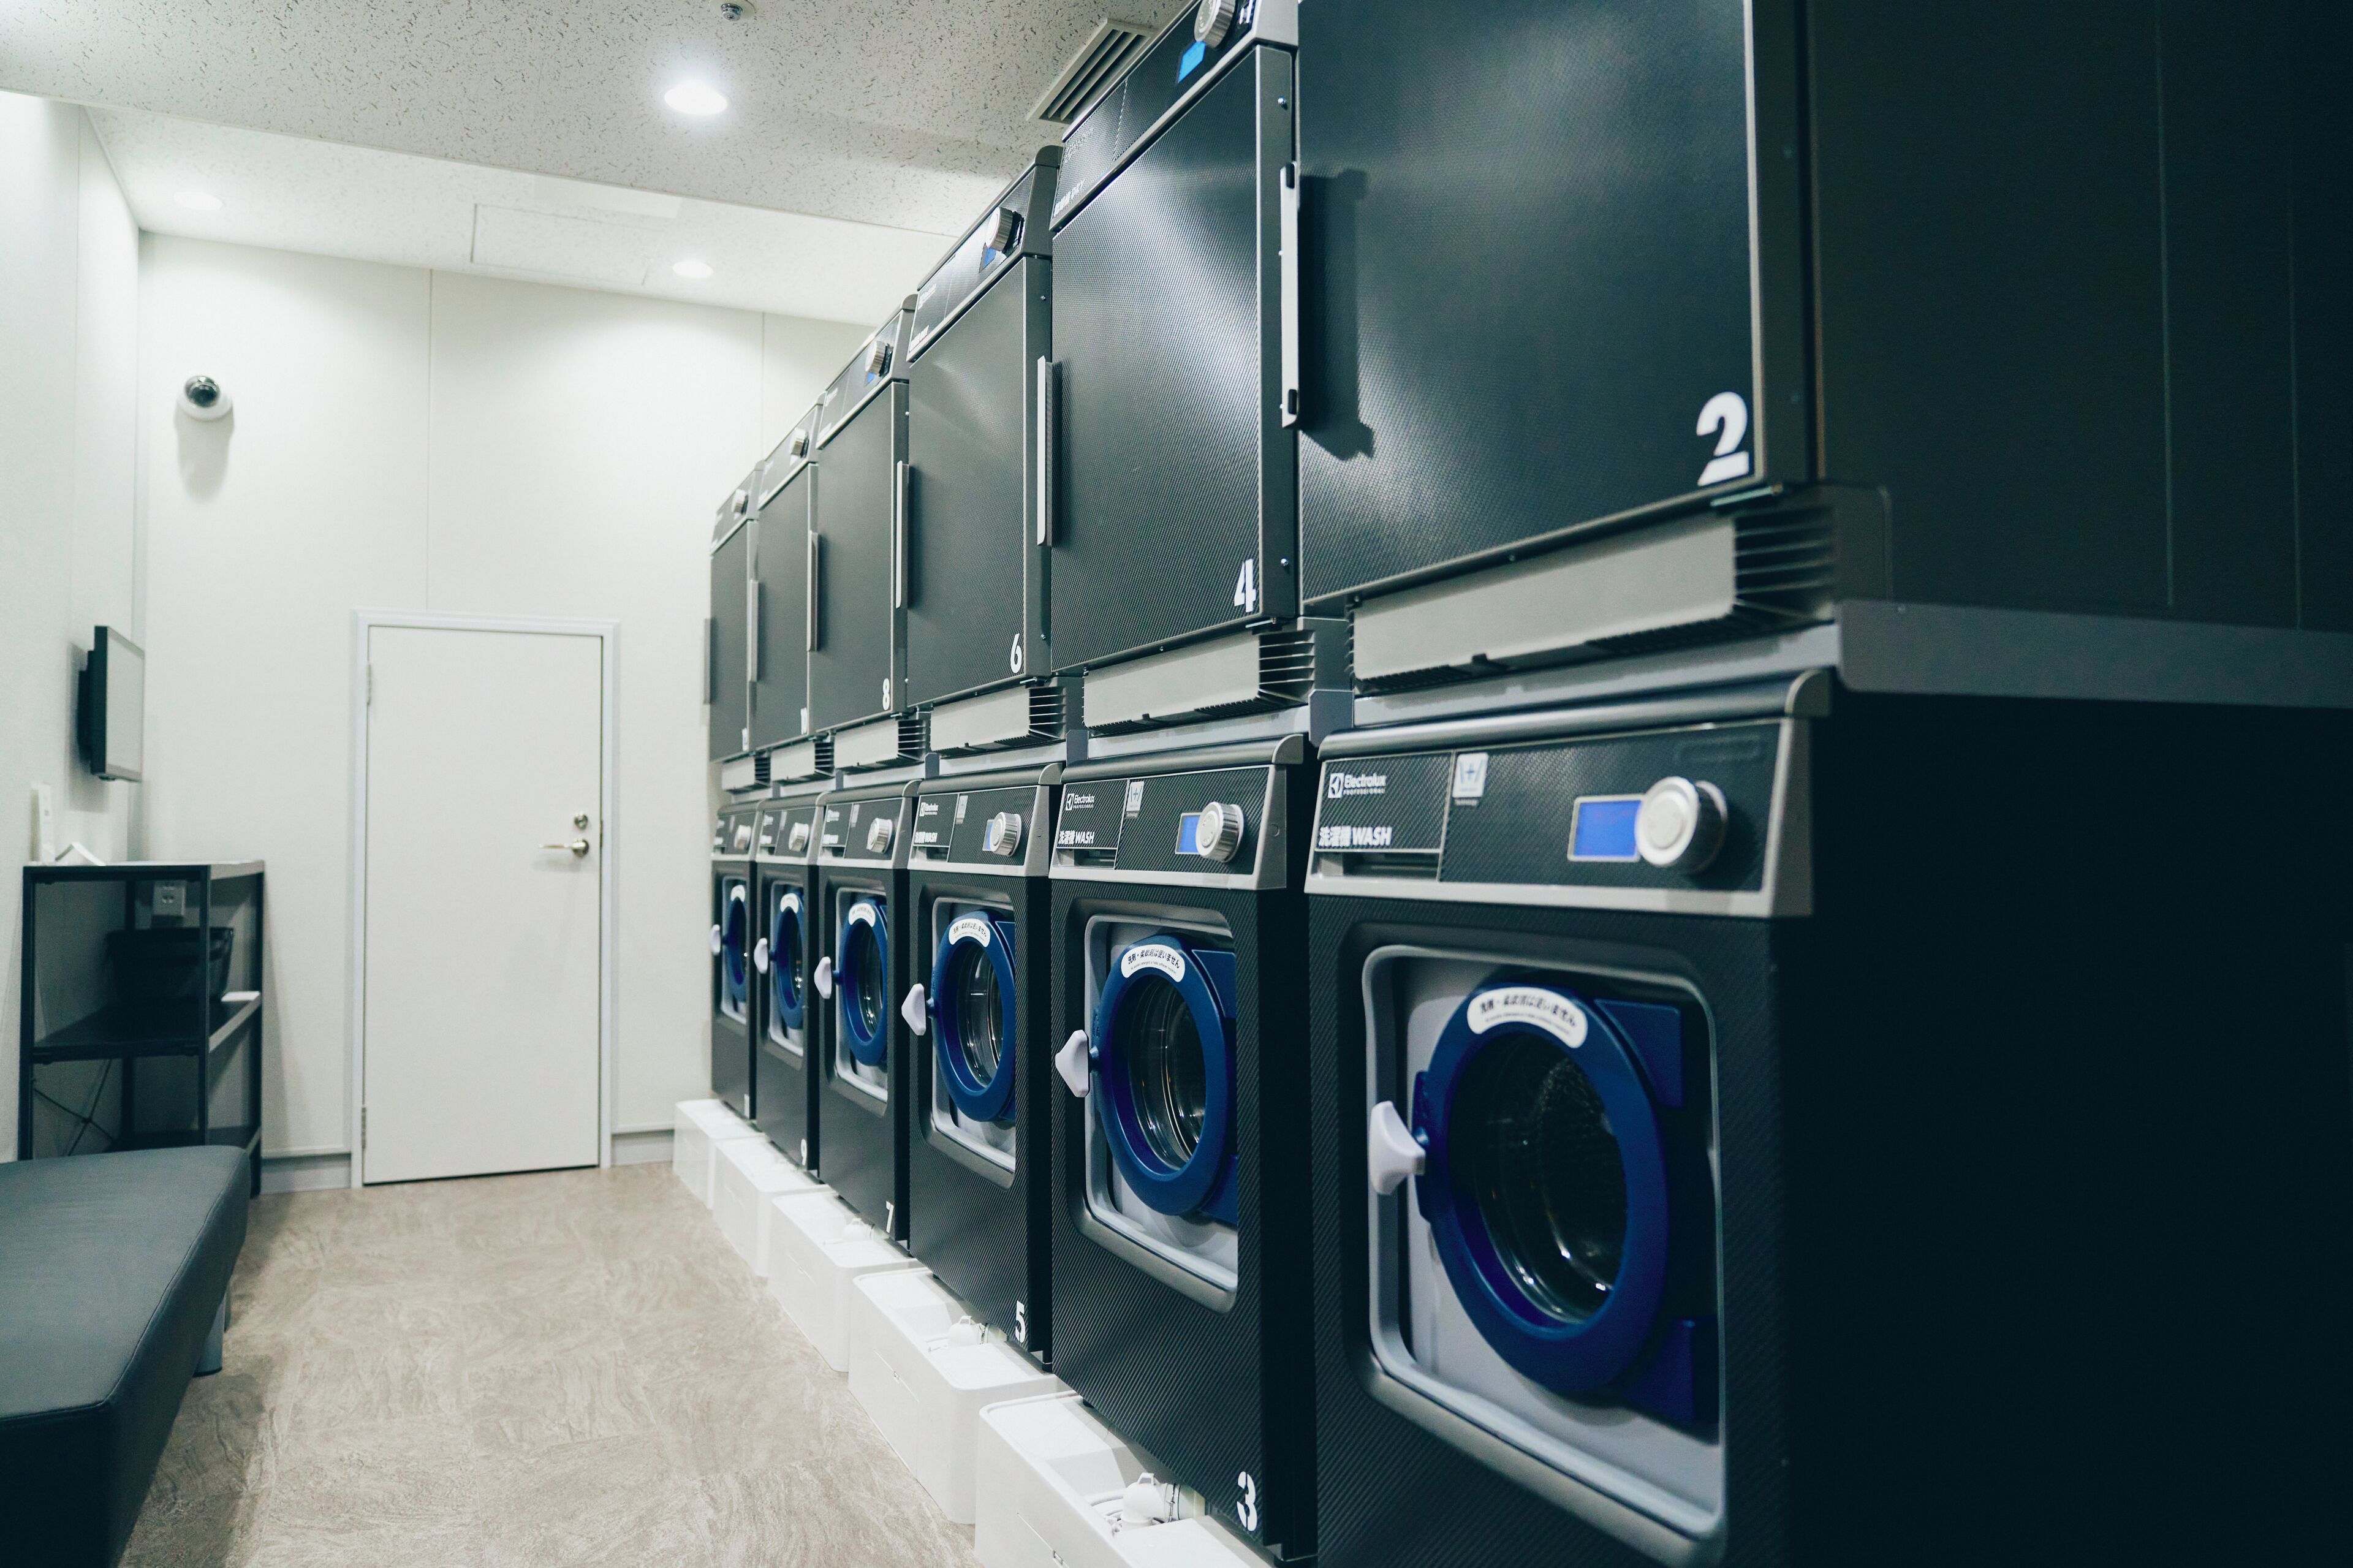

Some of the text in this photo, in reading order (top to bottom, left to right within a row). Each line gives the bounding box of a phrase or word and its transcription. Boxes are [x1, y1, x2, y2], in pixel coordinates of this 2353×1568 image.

[1696, 391, 1749, 487] 2
[1234, 558, 1256, 613] 4
[1010, 633, 1022, 673] 6
[882, 678, 890, 710] 8
[1344, 773, 1387, 788] Electrolux
[1074, 793, 1096, 803] Electrolux
[1075, 831, 1095, 844] WASH
[1352, 827, 1393, 846] WASH
[800, 1138, 808, 1165] 9
[886, 1200, 894, 1233] 7
[1015, 1300, 1026, 1343] 5
[1237, 1471, 1257, 1531] 3
